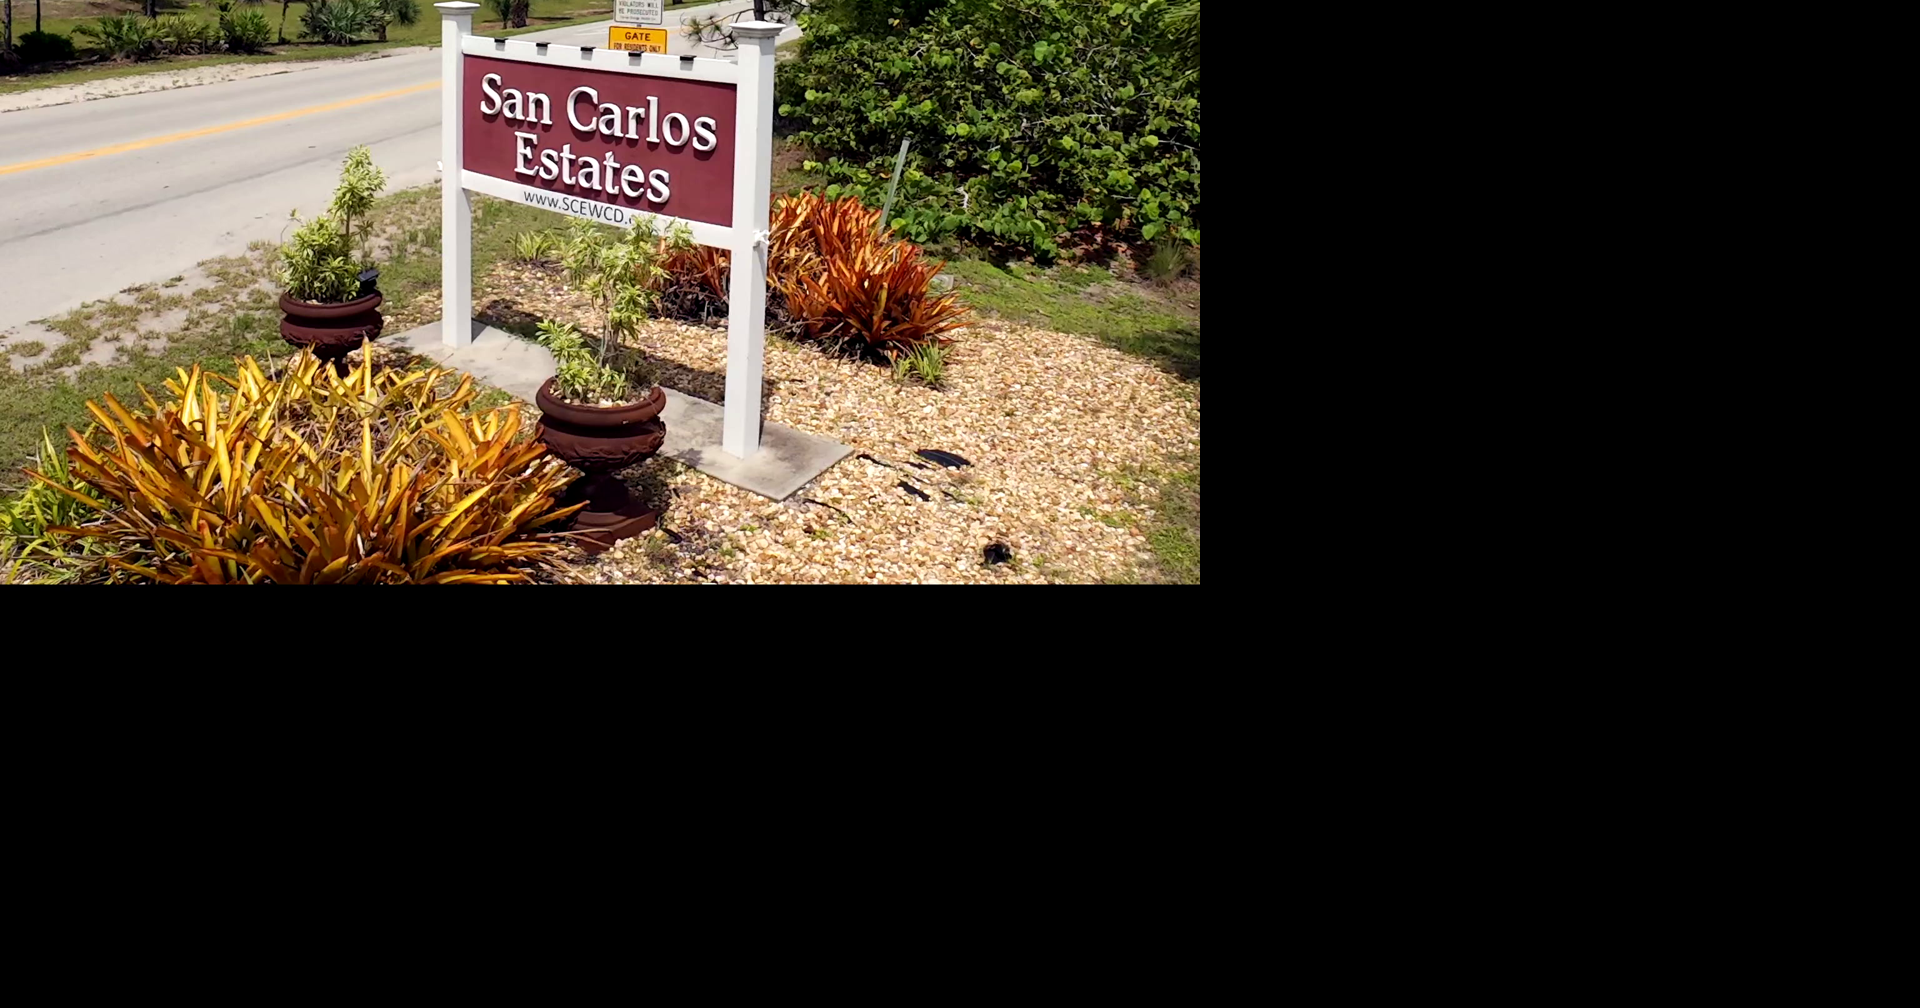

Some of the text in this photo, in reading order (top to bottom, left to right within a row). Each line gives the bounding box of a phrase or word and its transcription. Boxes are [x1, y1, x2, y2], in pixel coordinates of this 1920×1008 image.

[627, 8, 659, 16] PROSECUTED
[613, 42, 661, 53] FOR RESIDENTS ONLY
[624, 32, 651, 41] GATE
[480, 73, 718, 152] San Carlos
[514, 131, 671, 204] Estates
[523, 191, 634, 226] www.SCEWCD.
